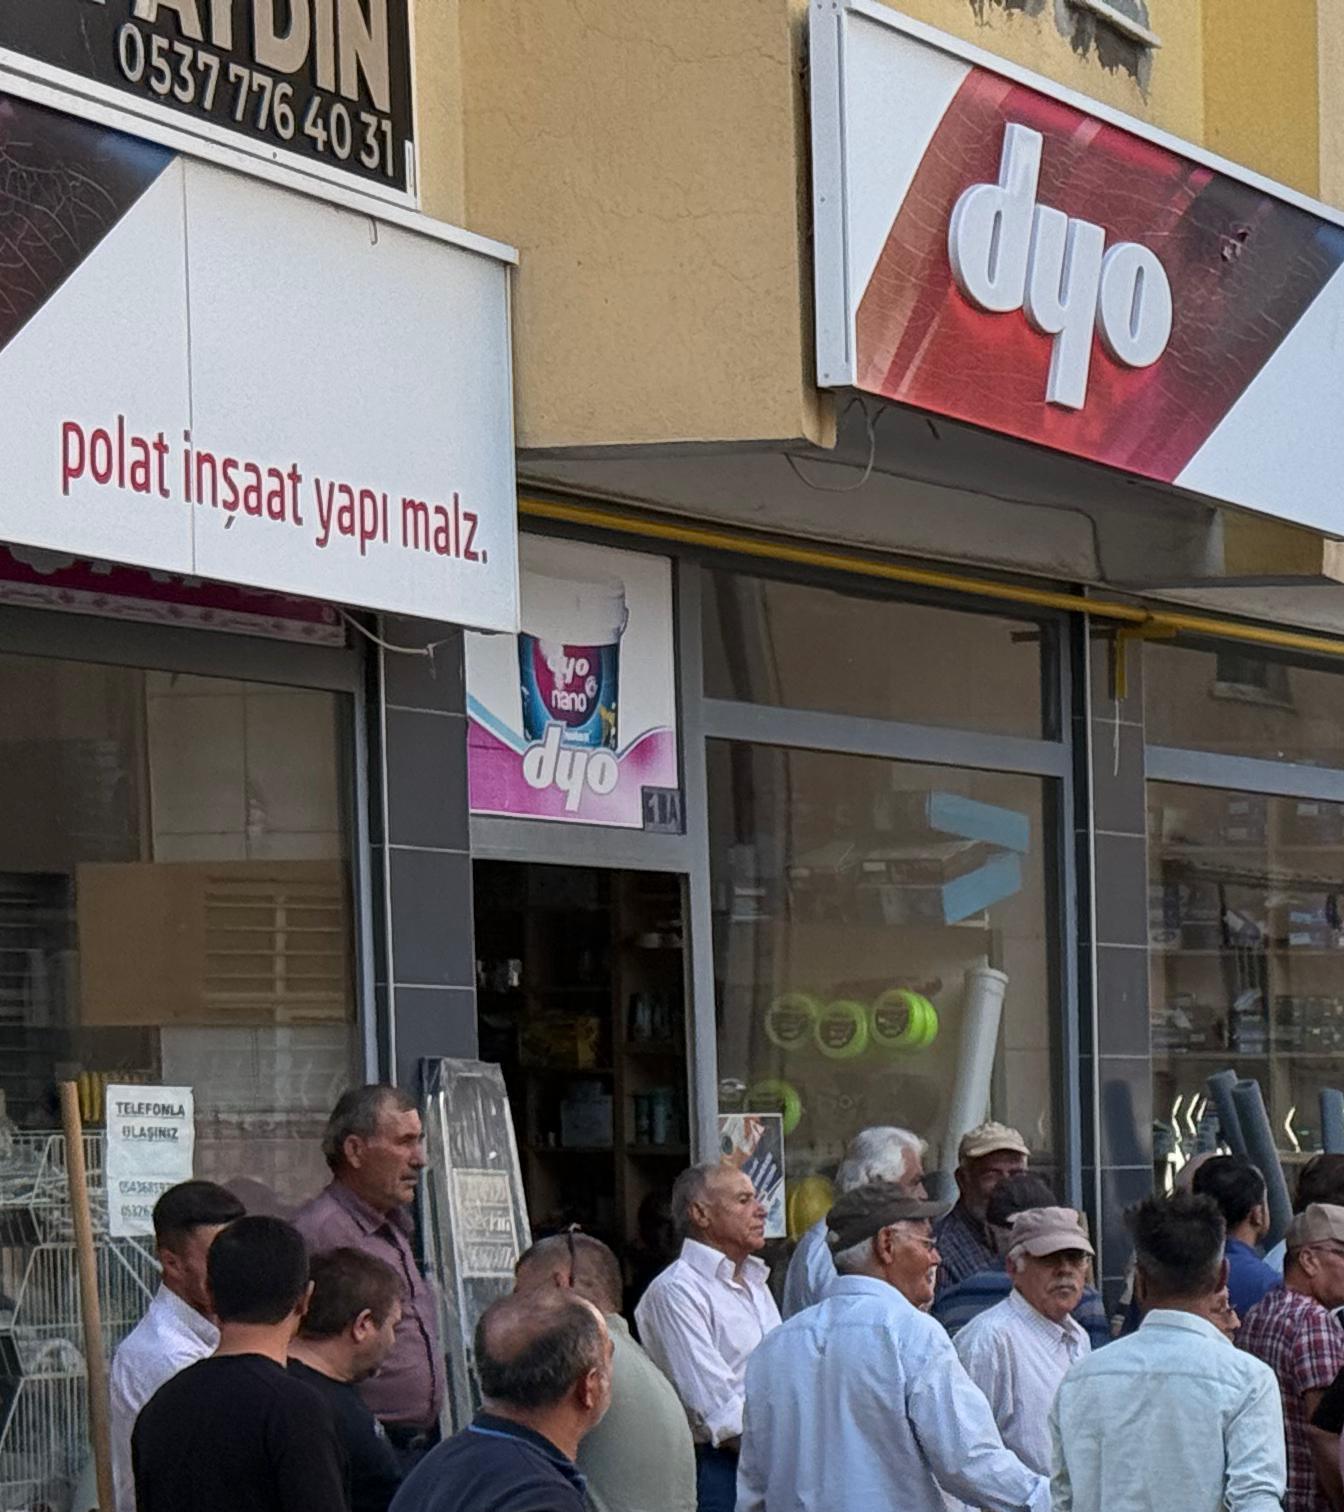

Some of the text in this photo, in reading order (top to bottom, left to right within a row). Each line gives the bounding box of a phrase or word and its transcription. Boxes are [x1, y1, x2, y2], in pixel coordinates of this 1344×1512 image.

[229, 62, 295, 140] 776
[303, 96, 350, 159] 40
[360, 112, 393, 176] 31
[948, 121, 1173, 411] dyo
[62, 414, 488, 564] polat inşaat yapı malz.
[551, 689, 587, 713] nano
[522, 720, 620, 813] dyo
[115, 1102, 186, 1117] TELEFONLA
